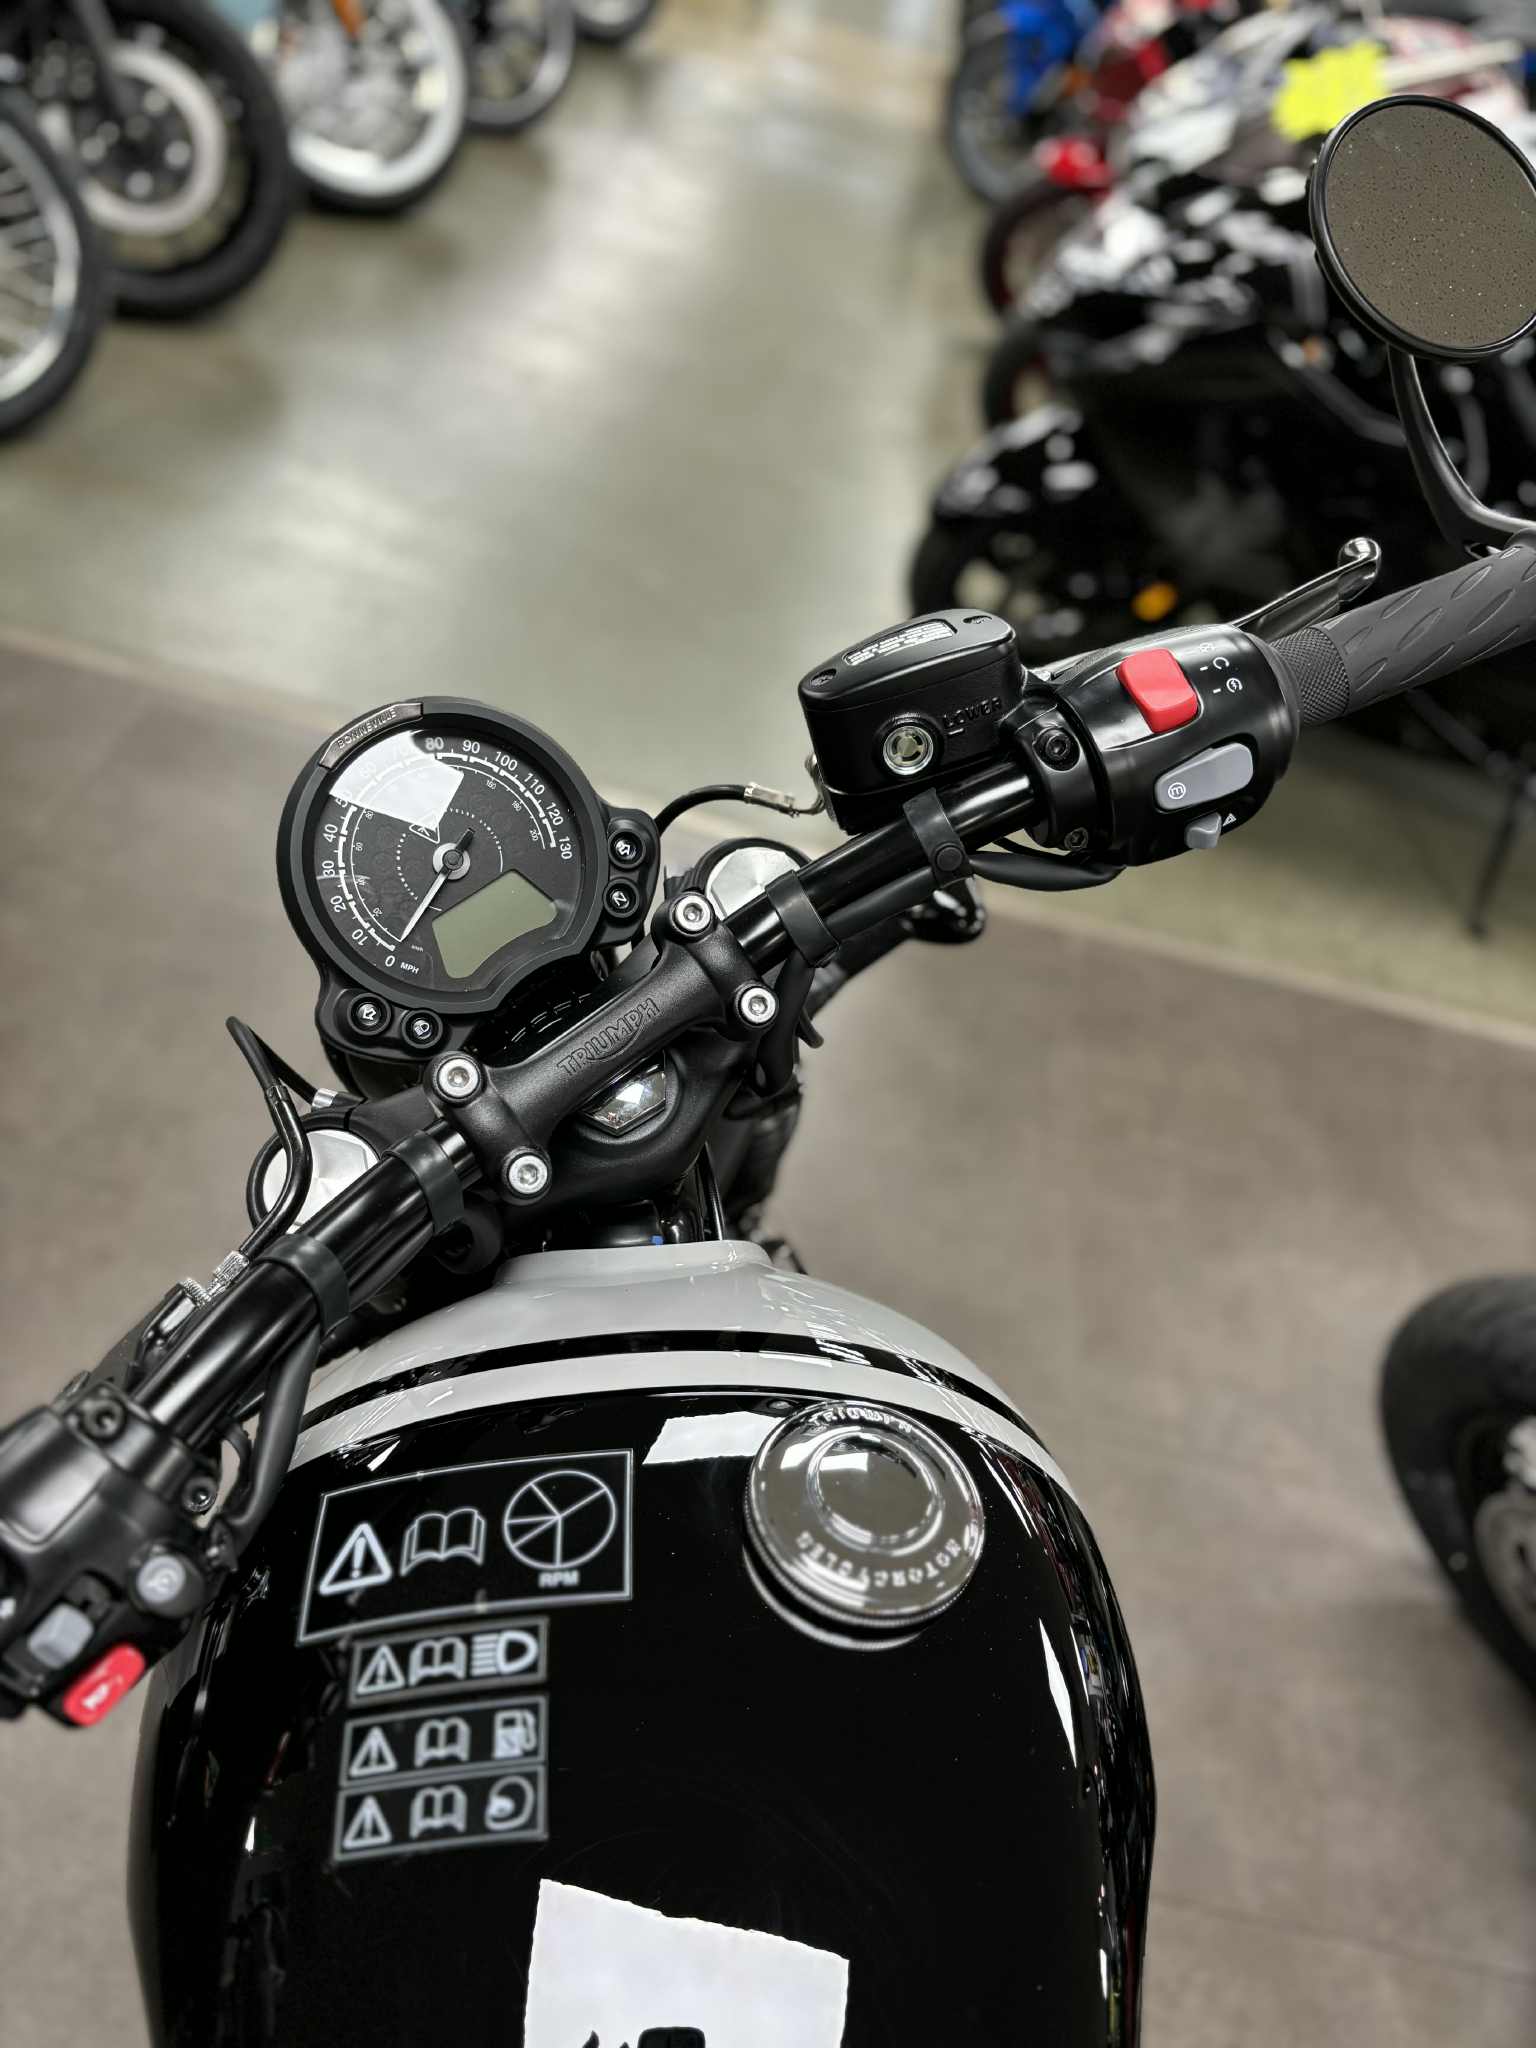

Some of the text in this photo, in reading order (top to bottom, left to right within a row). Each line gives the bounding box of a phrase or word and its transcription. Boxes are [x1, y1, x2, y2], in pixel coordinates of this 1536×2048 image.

[943, 696, 1000, 728] LOWER
[337, 708, 397, 749] BONNEVILLE
[425, 737, 445, 751] 80
[462, 739, 481, 754] 90
[494, 751, 518, 772] 100
[523, 772, 545, 796] 110
[545, 802, 564, 826] 120
[323, 823, 339, 843] 40
[558, 836, 573, 860] 130
[321, 860, 336, 878] 30
[330, 895, 347, 913] 20
[351, 928, 369, 947] 10
[384, 954, 396, 968] 0
[400, 961, 420, 975] MPH
[556, 997, 661, 1076] TRIUMPH
[537, 1570, 580, 1588] RPM
